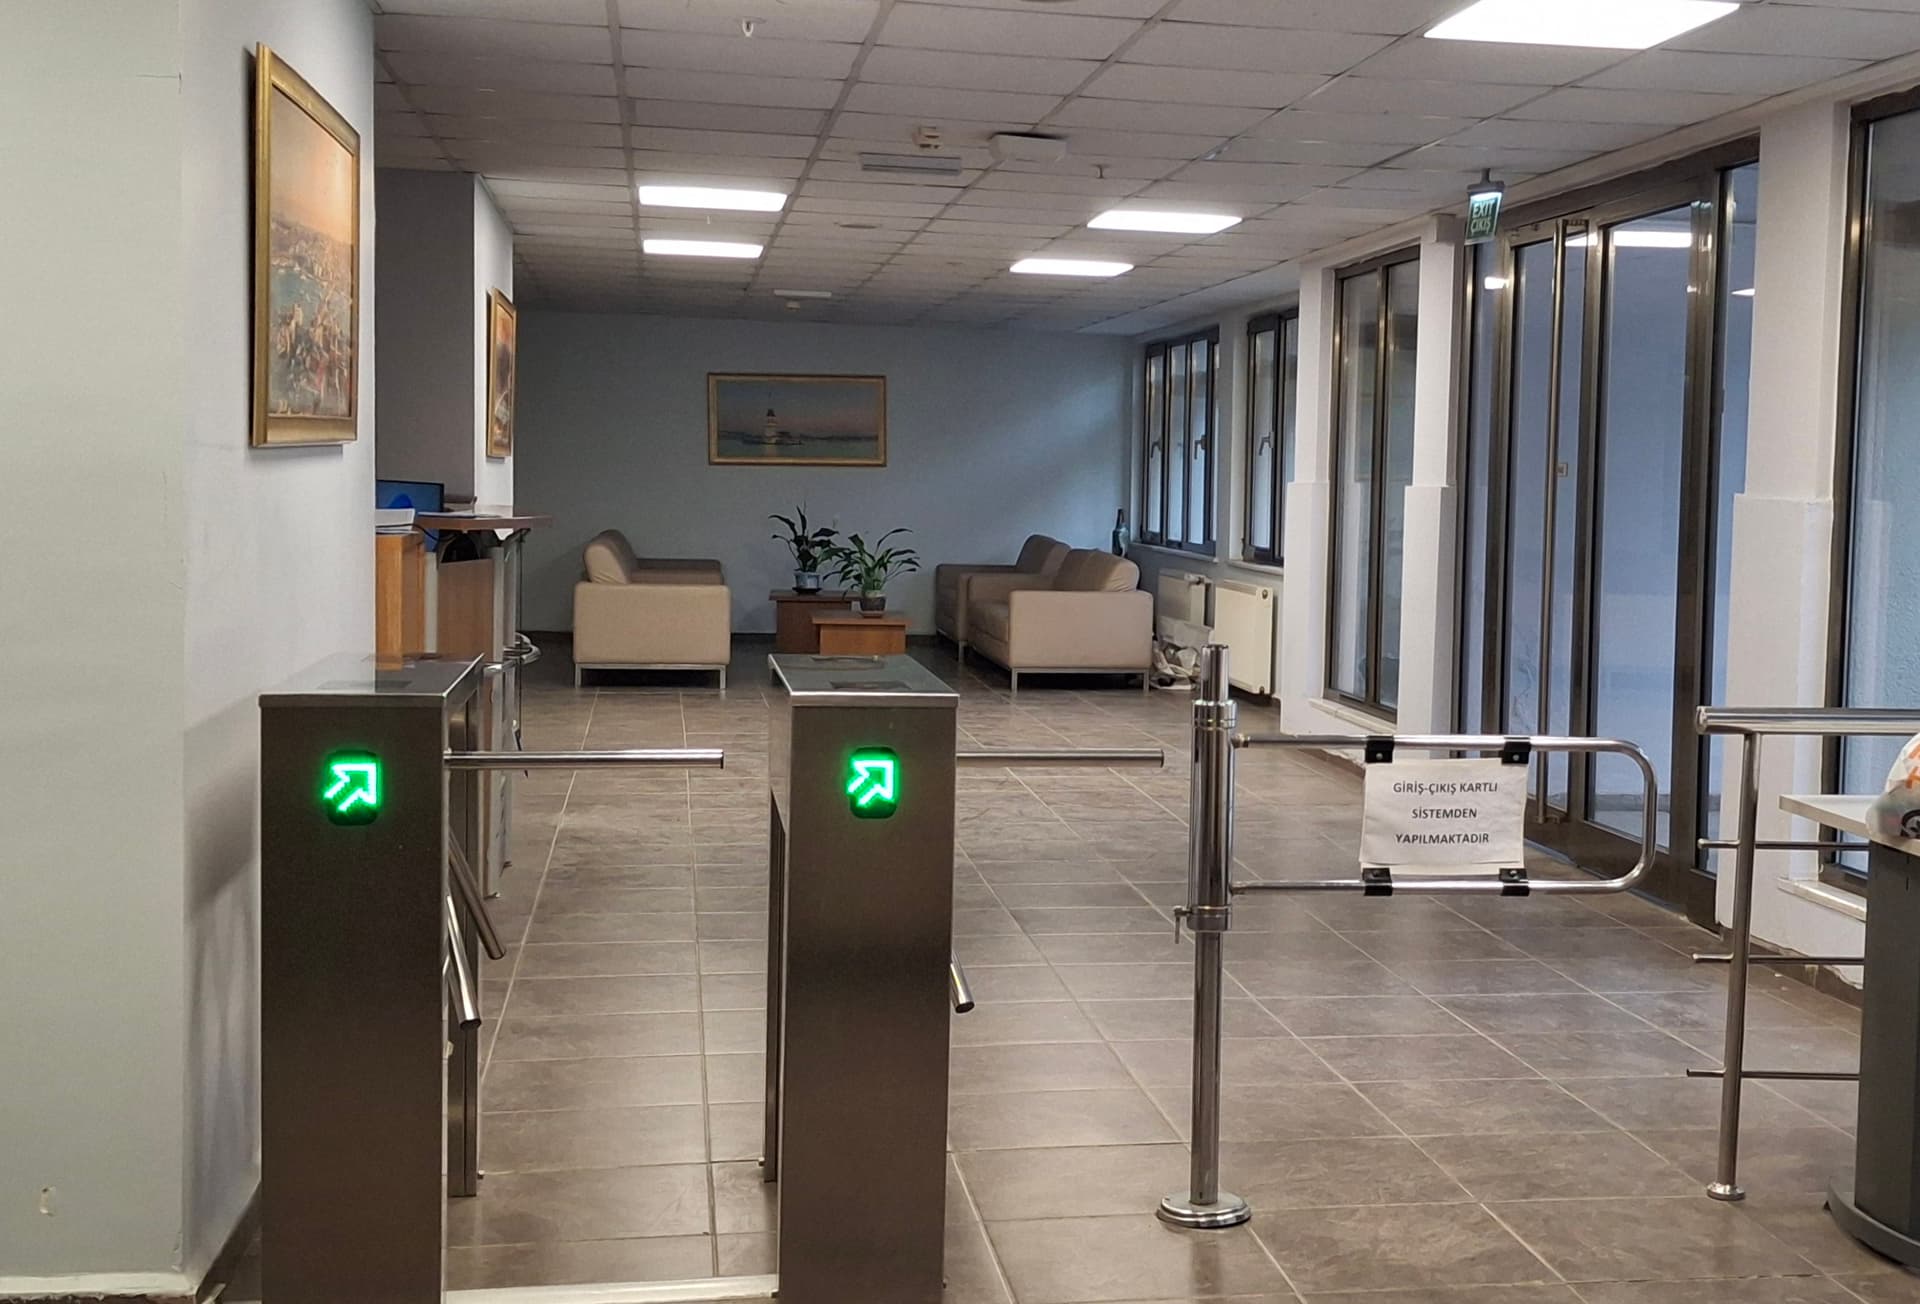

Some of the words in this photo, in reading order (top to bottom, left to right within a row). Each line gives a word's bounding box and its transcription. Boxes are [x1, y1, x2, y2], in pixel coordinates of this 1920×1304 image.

[1472, 200, 1495, 219] EXIT
[1393, 780, 1457, 795] GİRİŞ-ÇIKIŞ
[1459, 782, 1498, 793] KARTLI
[1411, 806, 1478, 819] SİSTEMDEN
[1395, 833, 1489, 844] YAPILMAKTADIR
